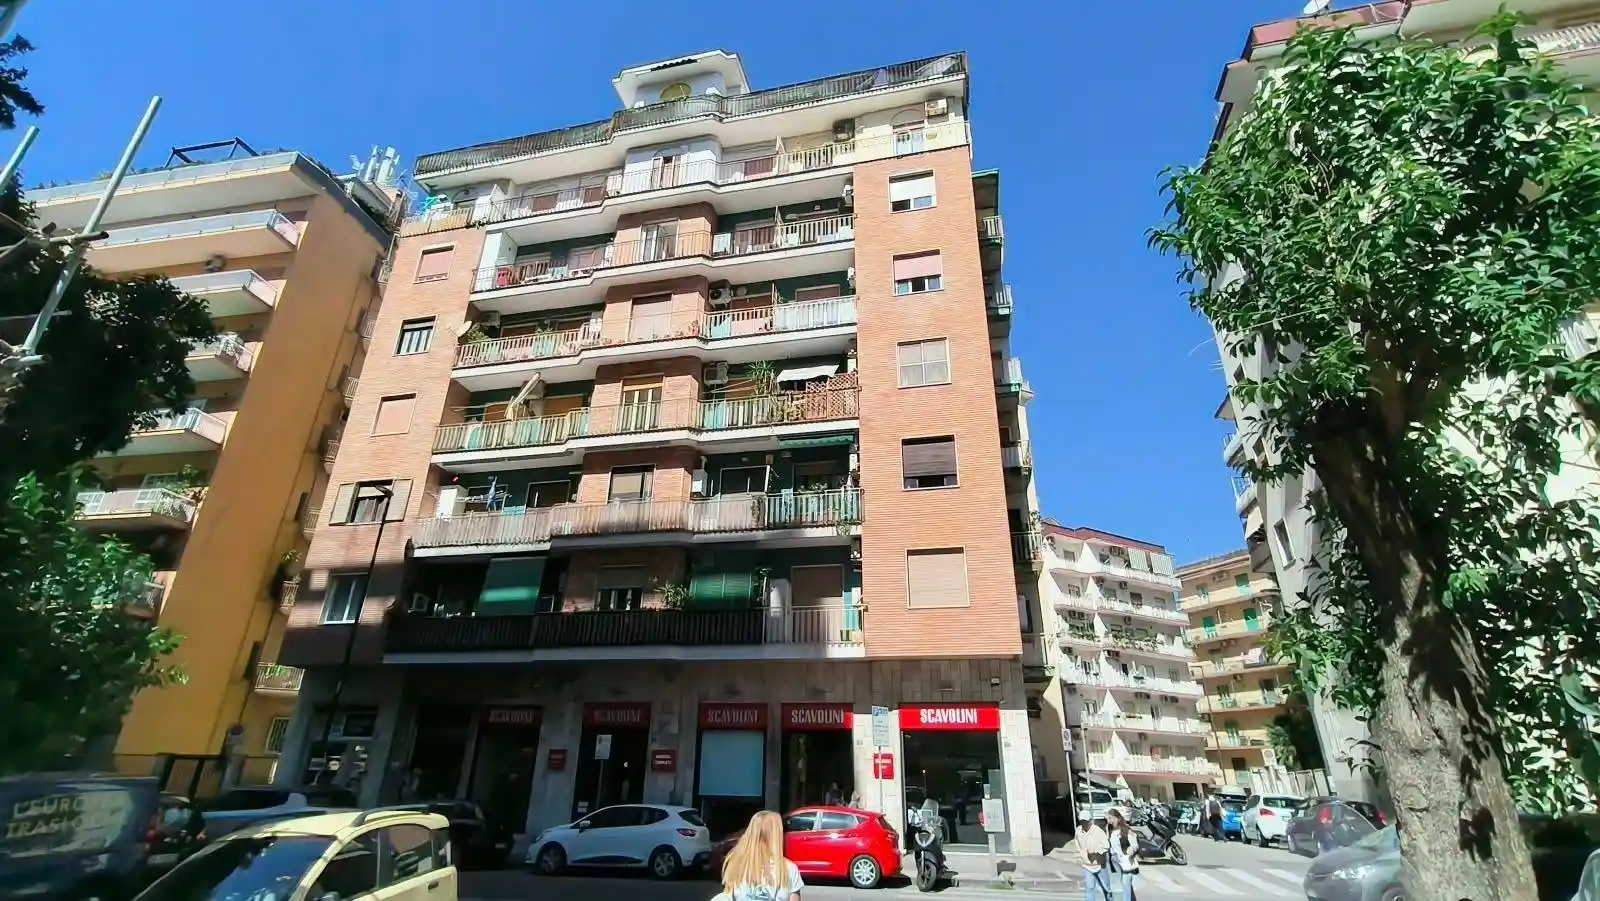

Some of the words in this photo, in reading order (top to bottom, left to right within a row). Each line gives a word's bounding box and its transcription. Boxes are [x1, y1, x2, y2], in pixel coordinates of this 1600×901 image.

[708, 708, 758, 723] SCAVOLINI
[791, 709, 844, 724] SCAVOLINI
[920, 708, 978, 724] SCAVOLINI
